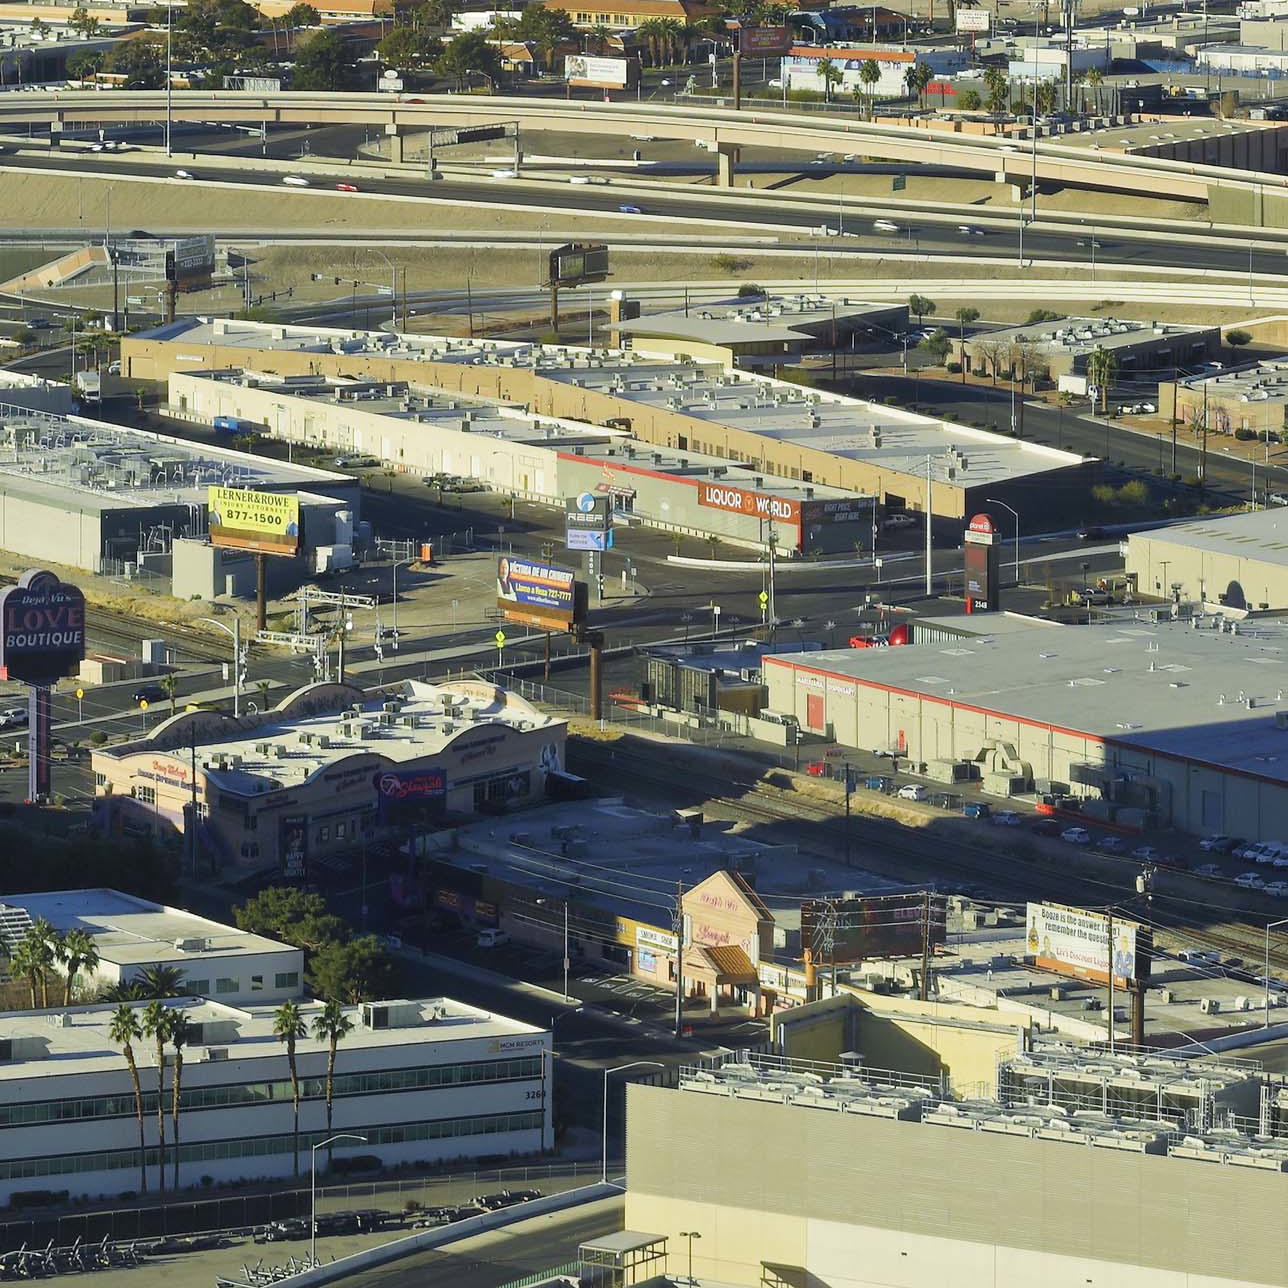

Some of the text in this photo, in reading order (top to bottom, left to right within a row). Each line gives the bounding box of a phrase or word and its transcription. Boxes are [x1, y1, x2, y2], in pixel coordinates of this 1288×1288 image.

[705, 487, 792, 519] LIQUOR WORLD
[227, 509, 282, 525] 877-1500
[567, 513, 604, 522] REEF
[8, 606, 83, 632] LOVE
[6, 631, 82, 648] BOUTIQUE
[1041, 908, 1059, 921] Booze
[1060, 913, 1066, 923] is
[1067, 914, 1077, 925] the
[1044, 922, 1077, 937] remember
[1077, 929, 1088, 939] the
